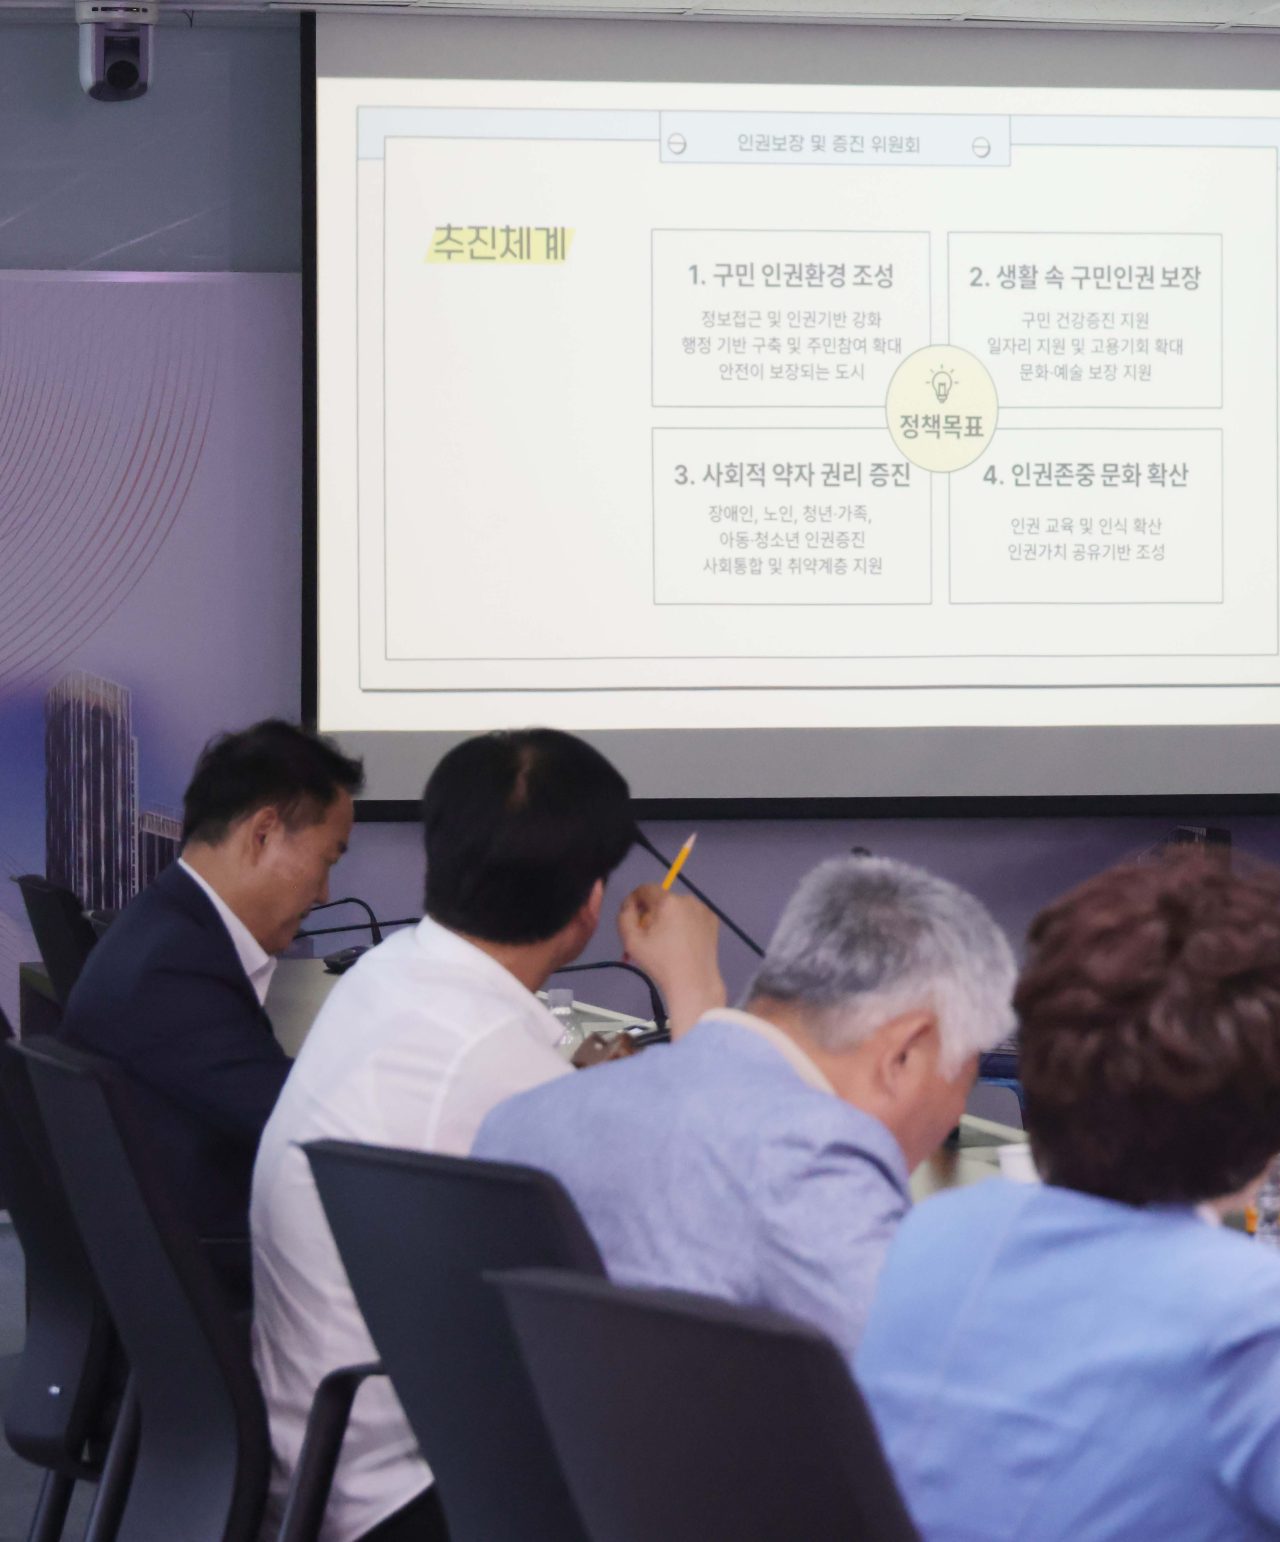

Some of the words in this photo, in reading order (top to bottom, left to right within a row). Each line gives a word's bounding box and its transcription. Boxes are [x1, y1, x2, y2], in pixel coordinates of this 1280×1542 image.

[738, 134, 805, 152] 인권보장
[811, 134, 826, 152] 및
[832, 135, 864, 153] 증진
[872, 136, 920, 154] 위원회
[434, 223, 565, 260] 추진체계
[689, 264, 706, 285] 1.
[713, 262, 754, 288] 구민
[762, 262, 845, 288] 인권환경
[852, 264, 893, 289] 조성
[970, 266, 990, 287] 2.
[997, 264, 1039, 290] 생활
[1044, 265, 1064, 290] 속
[1071, 265, 1154, 290] 구민인권
[1160, 265, 1201, 291] 보장
[702, 310, 762, 328] 정보접근
[767, 310, 781, 328] 및
[787, 310, 847, 328] 인권기반
[852, 311, 882, 329] 강화
[1022, 312, 1050, 329] 구민
[1057, 312, 1115, 330] 건강증진
[1120, 312, 1149, 330] 지원
[682, 336, 711, 355] 행정
[717, 336, 747, 354] 기반
[752, 336, 782, 354] 구축
[787, 336, 800, 355] 및
[807, 337, 867, 355] 주민참여
[872, 337, 901, 354] 확대
[987, 337, 1031, 355] 일자리
[1037, 337, 1065, 355] 지원
[1071, 337, 1085, 356] 및
[1091, 337, 1149, 356] 고용기회
[1155, 338, 1183, 355] 확대
[719, 363, 764, 381] 안전이
[769, 363, 830, 381] 보장되는
[835, 363, 864, 381] 도시
[1088, 363, 1118, 382] 보장
[1123, 364, 1151, 382] 지원
[900, 414, 984, 439] 정책목표
[674, 464, 695, 485] 3.
[702, 462, 765, 488] 사회적
[772, 462, 815, 487] 약자
[821, 462, 861, 488] 권리
[869, 462, 911, 488] 증진
[983, 465, 1004, 485] 4.
[1012, 462, 1096, 487] 인권존중
[1101, 462, 1142, 488] 문화
[1147, 462, 1189, 488] 확산
[708, 504, 758, 525] 장애인,
[764, 505, 797, 525] 노인,
[1011, 517, 1040, 535] 인권
[1045, 517, 1074, 535] 교육
[1080, 517, 1093, 535] 및
[1099, 517, 1127, 535] 인식
[1133, 517, 1162, 535] 확산
[805, 531, 864, 549] 인권증진
[1008, 543, 1066, 561] 인권가치
[1072, 544, 1131, 561] 공유기반
[1136, 544, 1165, 561] 조성
[703, 557, 763, 575] 사회통합
[768, 557, 782, 575] 및
[788, 557, 848, 575] 취약계층
[853, 557, 882, 575] 지원
